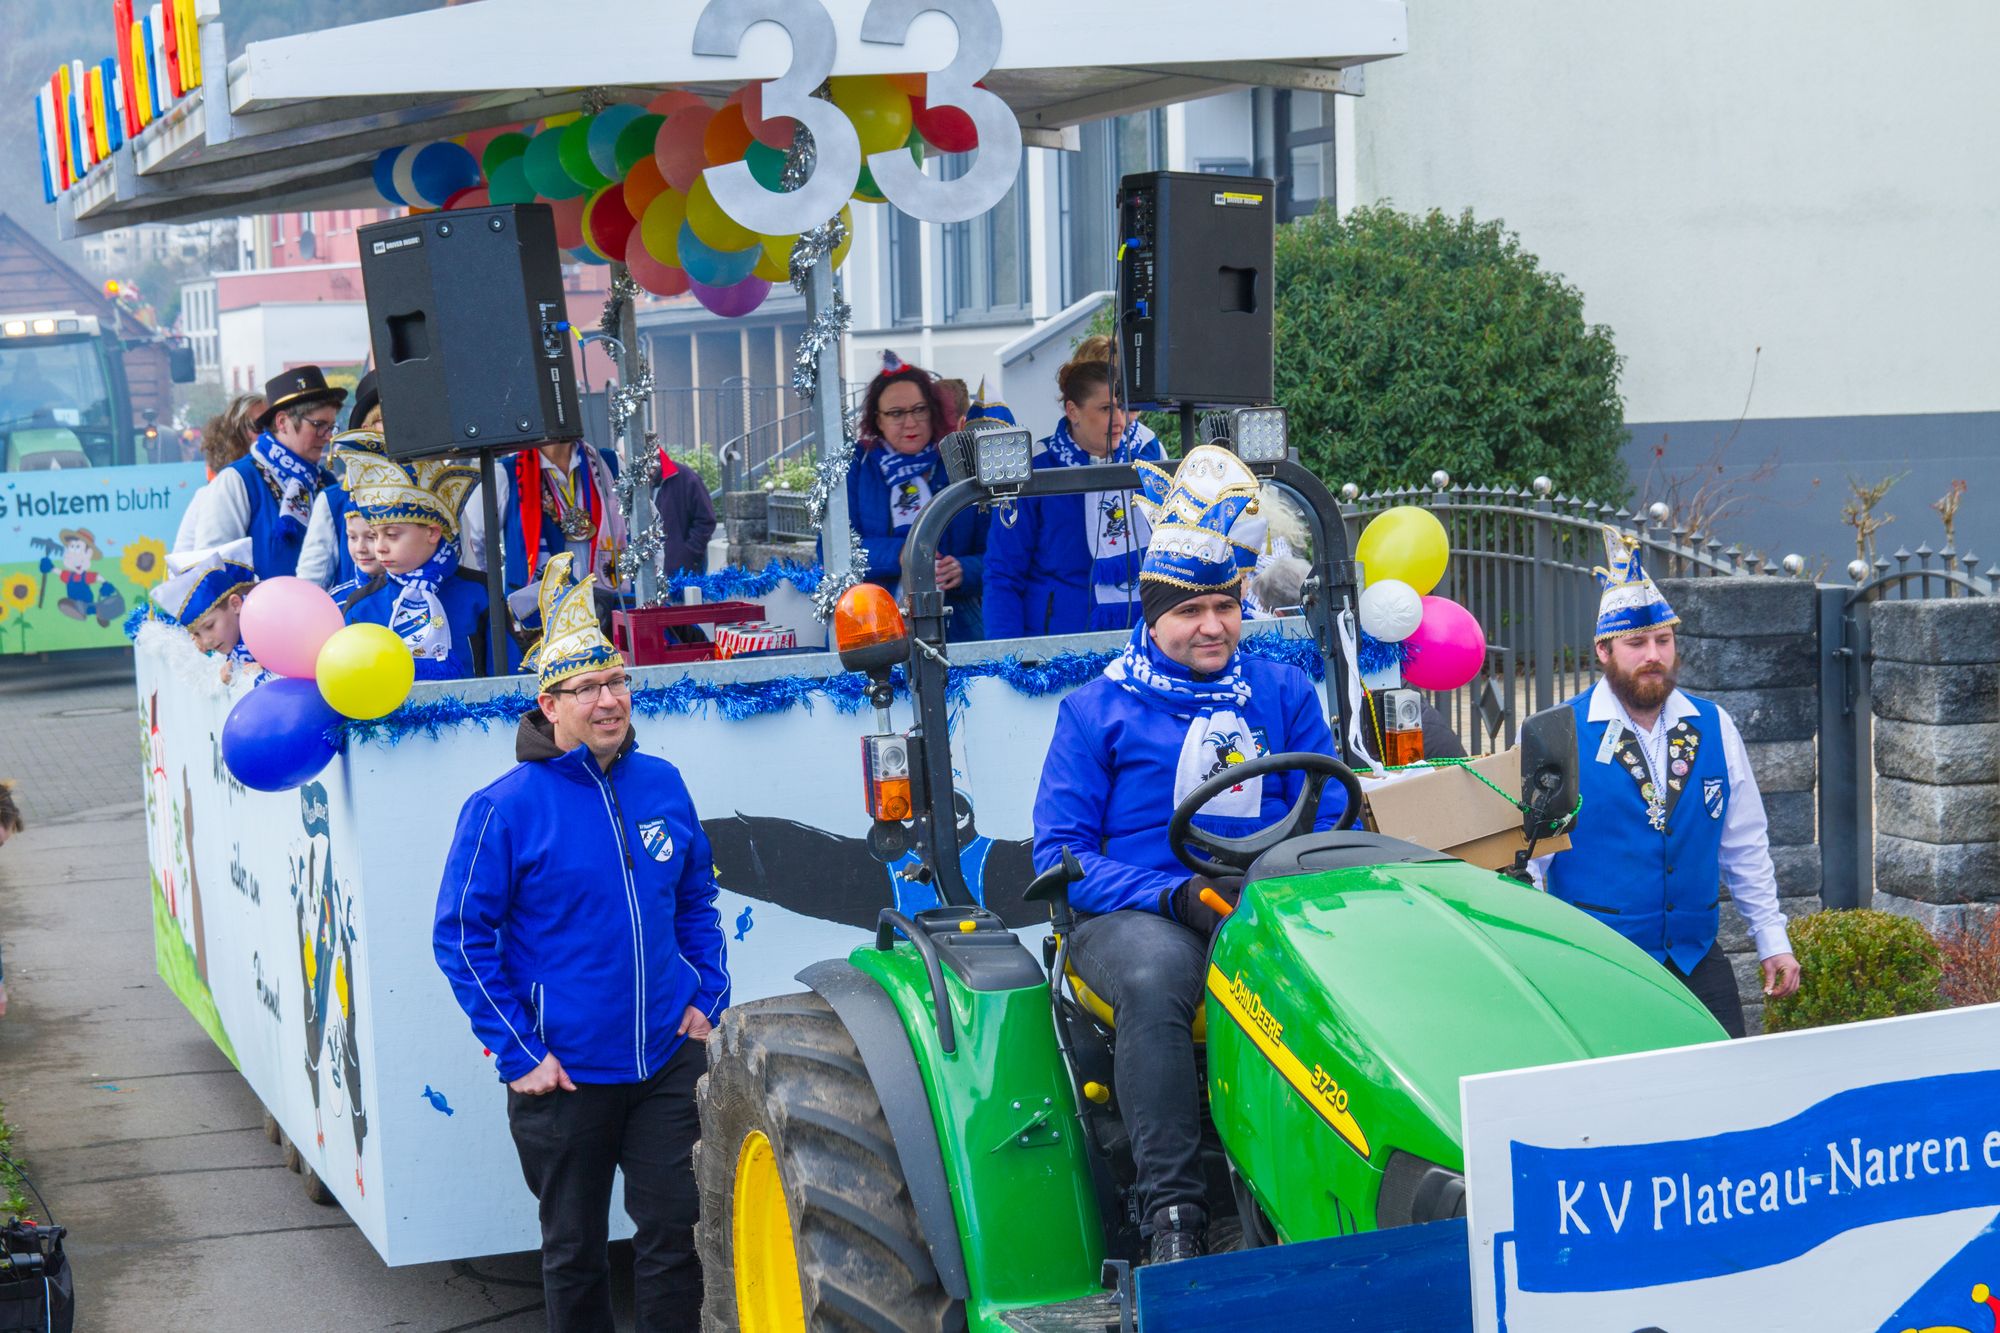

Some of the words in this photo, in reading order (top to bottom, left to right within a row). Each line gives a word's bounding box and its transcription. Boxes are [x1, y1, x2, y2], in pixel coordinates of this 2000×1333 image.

[692, 0, 1023, 236] 33
[16, 491, 109, 518] Holzem
[1230, 971, 1253, 1015] JOHN
[1250, 993, 1283, 1047] DEERE
[1311, 1063, 1349, 1114] 3720
[1651, 1136, 1970, 1230] Plateau-Narren
